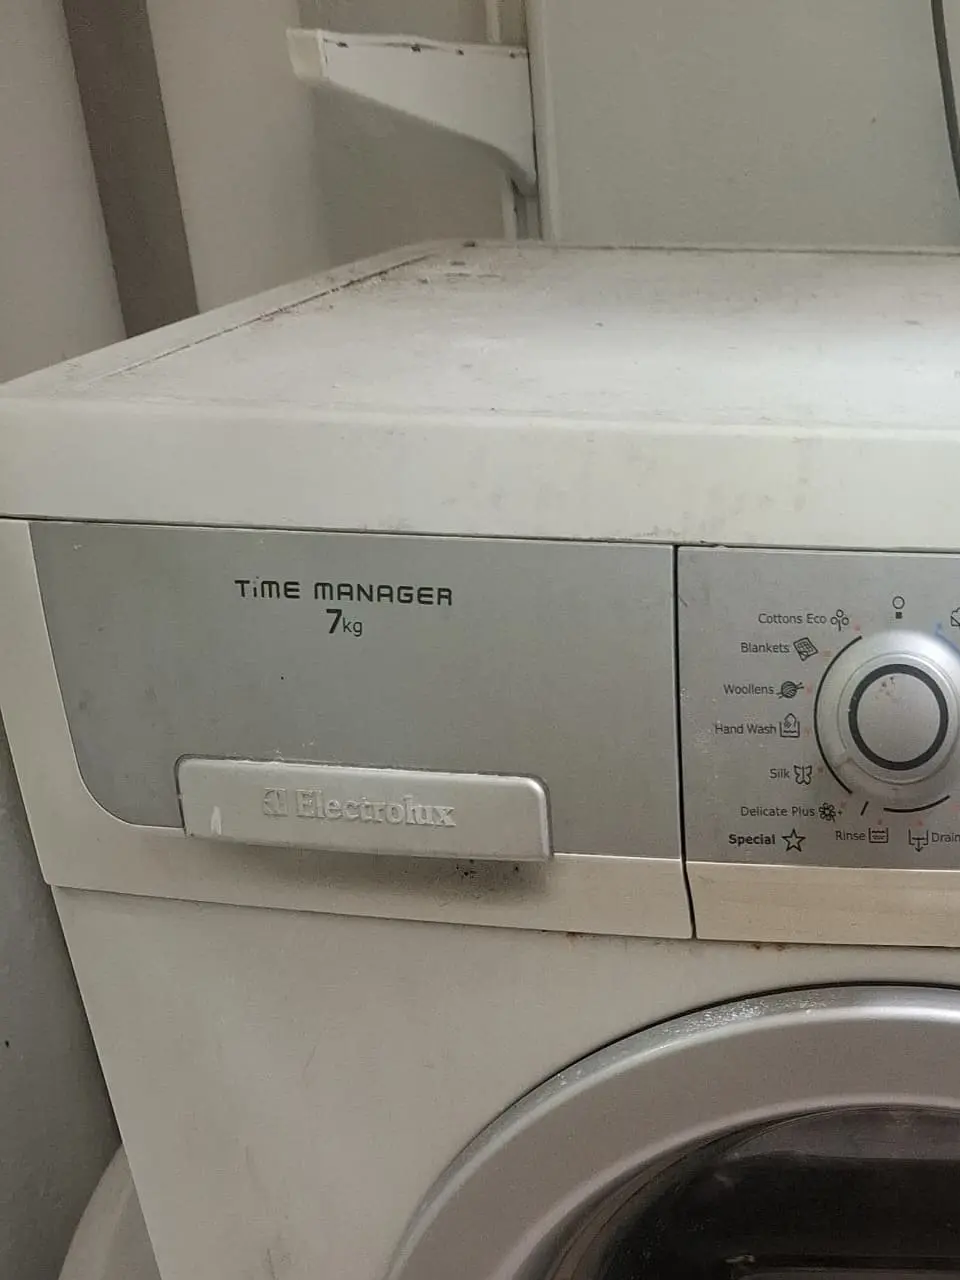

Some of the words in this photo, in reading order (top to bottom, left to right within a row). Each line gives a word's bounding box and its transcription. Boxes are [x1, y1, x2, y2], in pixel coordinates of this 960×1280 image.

[314, 582, 453, 607] MANAGER
[326, 608, 363, 637] 7kg
[758, 613, 799, 625] Cottons
[803, 613, 827, 625] Eco
[741, 642, 790, 654] Blankets
[723, 683, 774, 695] Woollens
[714, 723, 743, 735] Hand
[747, 723, 777, 735] Wash
[770, 768, 790, 779] Silk
[296, 790, 457, 827] Electrolux
[740, 806, 787, 818] Delicate
[792, 806, 815, 817] Plus
[728, 833, 776, 846] Special
[835, 831, 866, 842] Rinse
[932, 832, 960, 844] Drain
